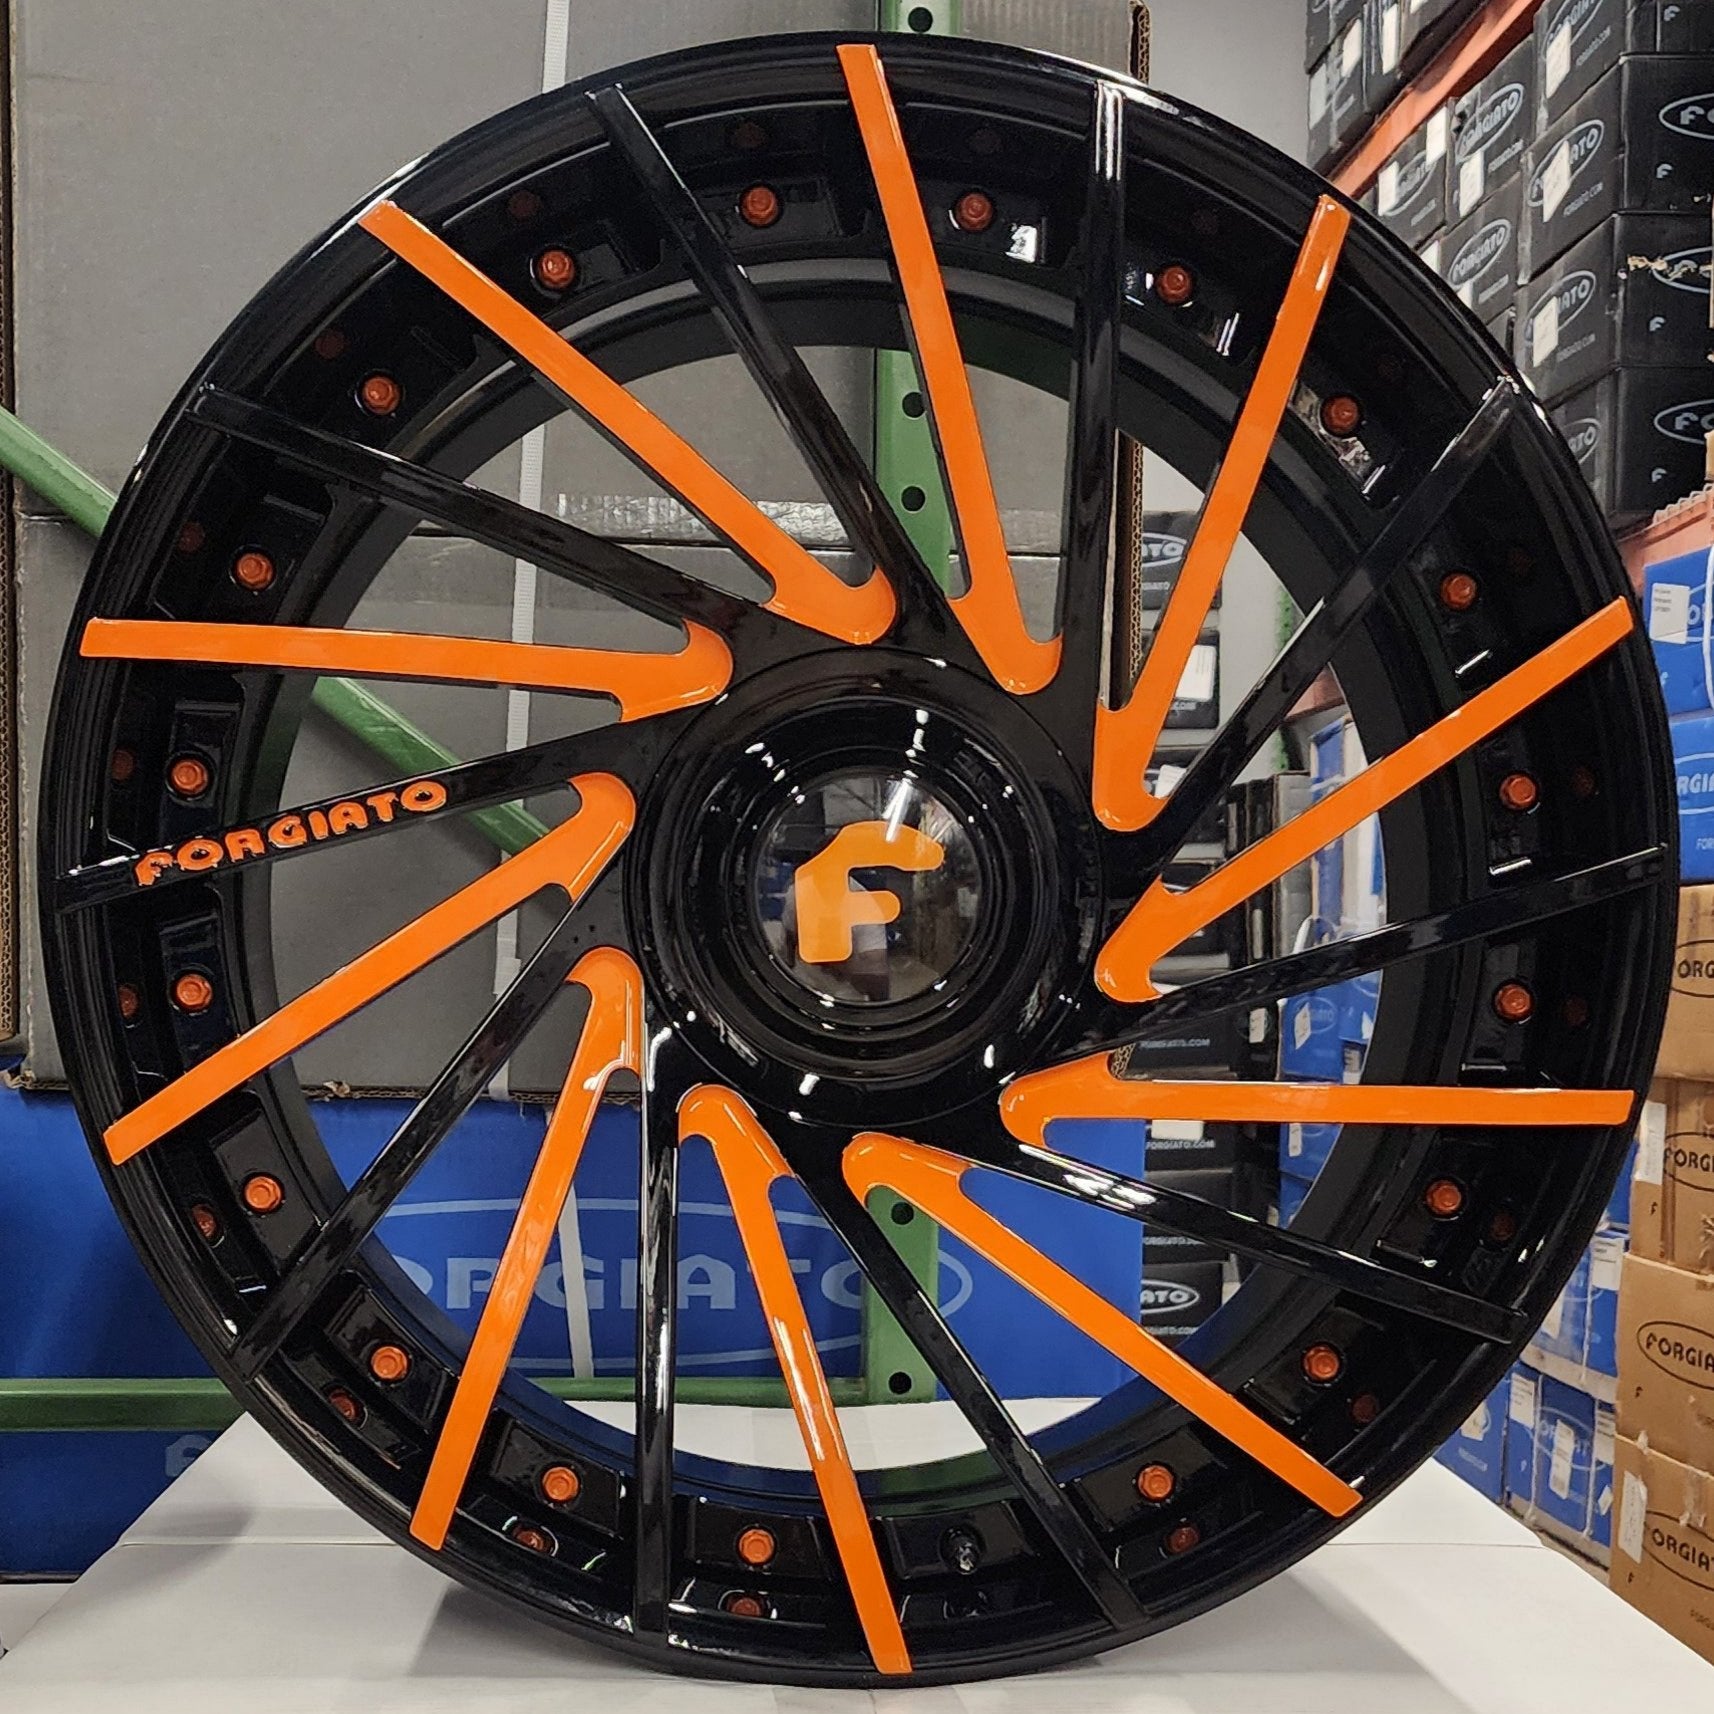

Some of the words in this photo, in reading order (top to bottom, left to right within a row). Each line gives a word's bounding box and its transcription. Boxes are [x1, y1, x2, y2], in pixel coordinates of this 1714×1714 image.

[1664, 5, 1680, 21] F
[1656, 163, 1673, 178] F
[1650, 316, 1666, 331] F
[1652, 468, 1667, 482] F
[135, 780, 447, 887] FORGIATO
[795, 820, 945, 964] F
[1645, 1522, 1714, 1572] ORGIA
